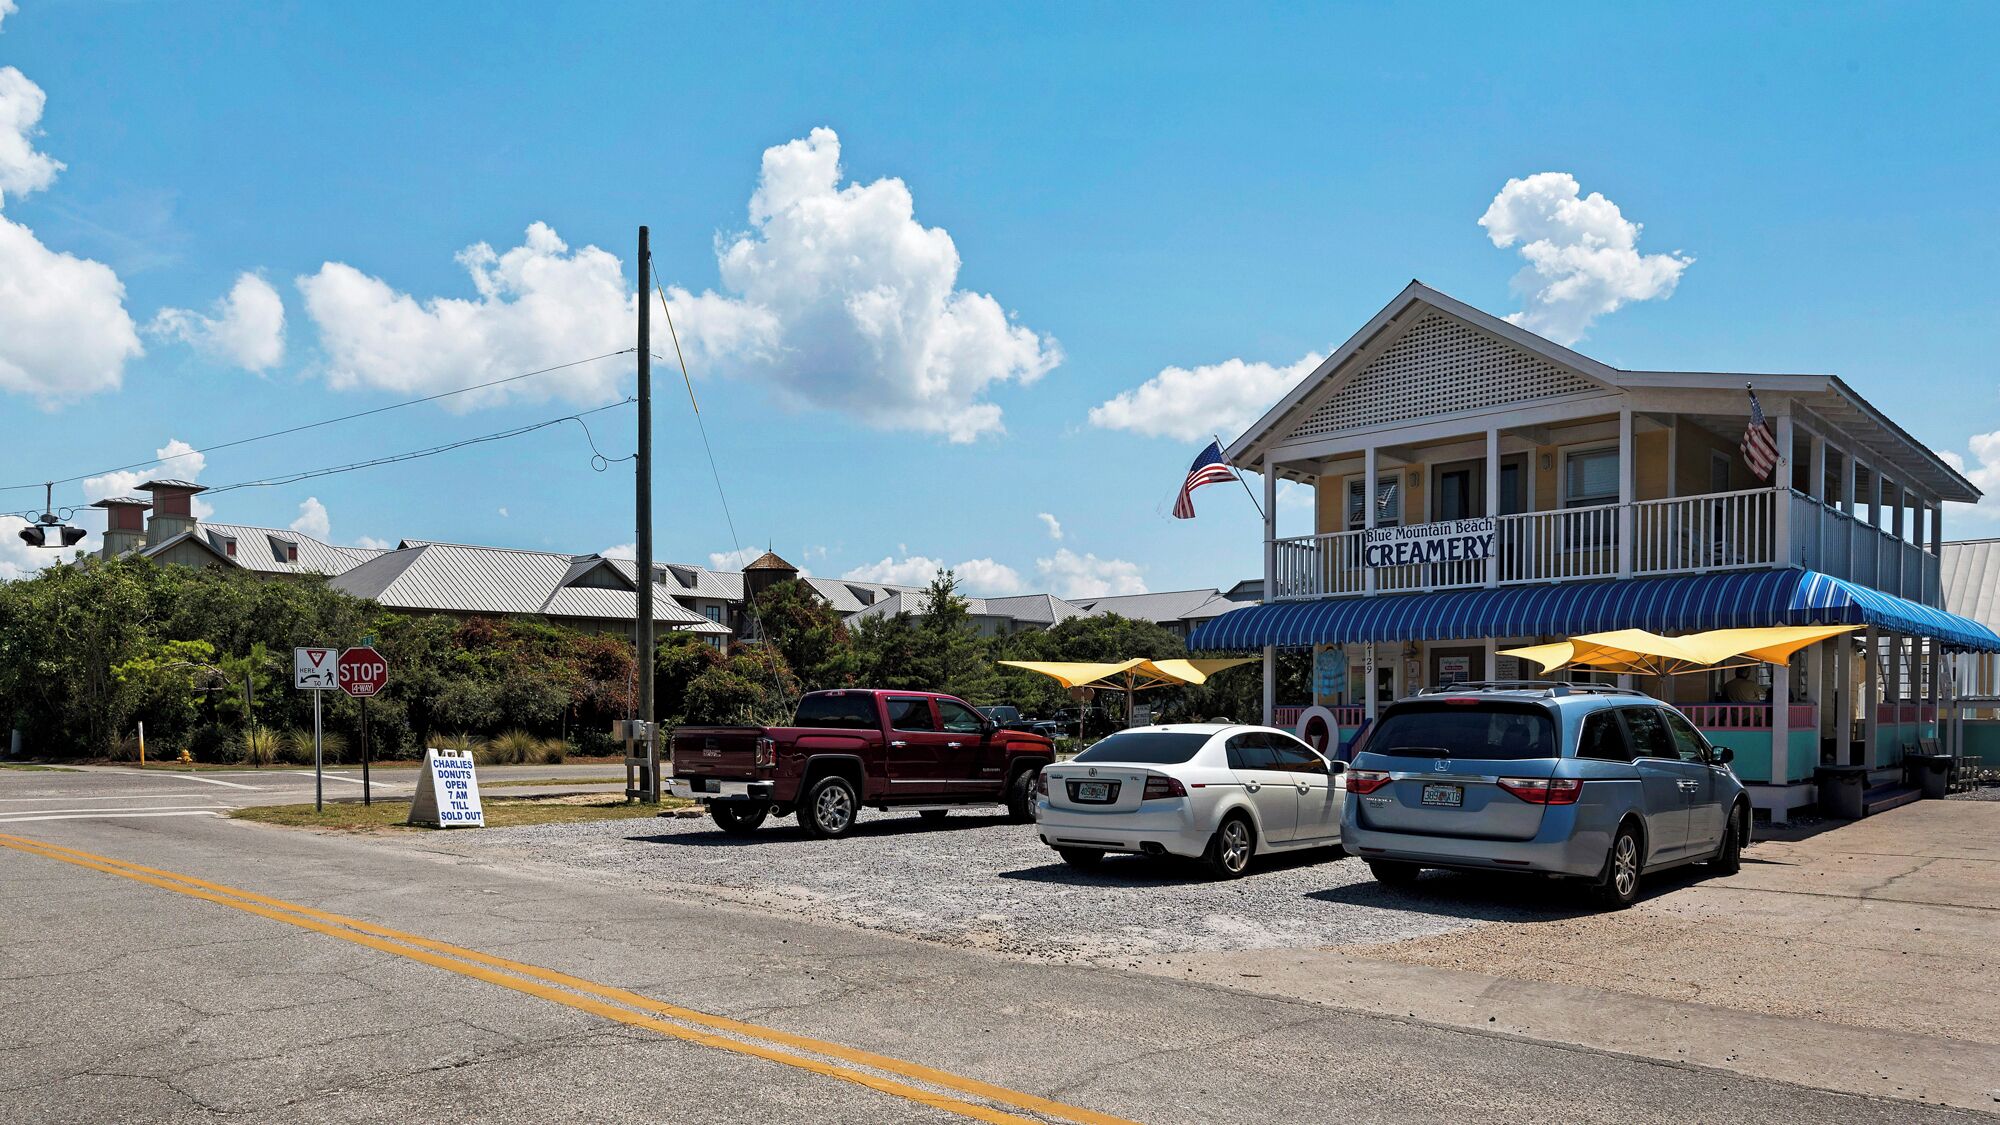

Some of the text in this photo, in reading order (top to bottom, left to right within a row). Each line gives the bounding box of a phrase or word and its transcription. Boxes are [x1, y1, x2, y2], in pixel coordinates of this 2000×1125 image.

[1367, 519, 1493, 543] Blue Mountain Beach
[1366, 534, 1494, 567] CREAMERY
[339, 663, 384, 682] STOP
[353, 683, 372, 693] 4-WAY
[433, 759, 473, 769] CHARLIES
[438, 769, 472, 779] DONUTS
[445, 780, 468, 790] OPEN
[448, 790, 468, 800] 7 AM
[450, 801, 469, 810] TILL
[441, 811, 481, 821] SOLD OUT
